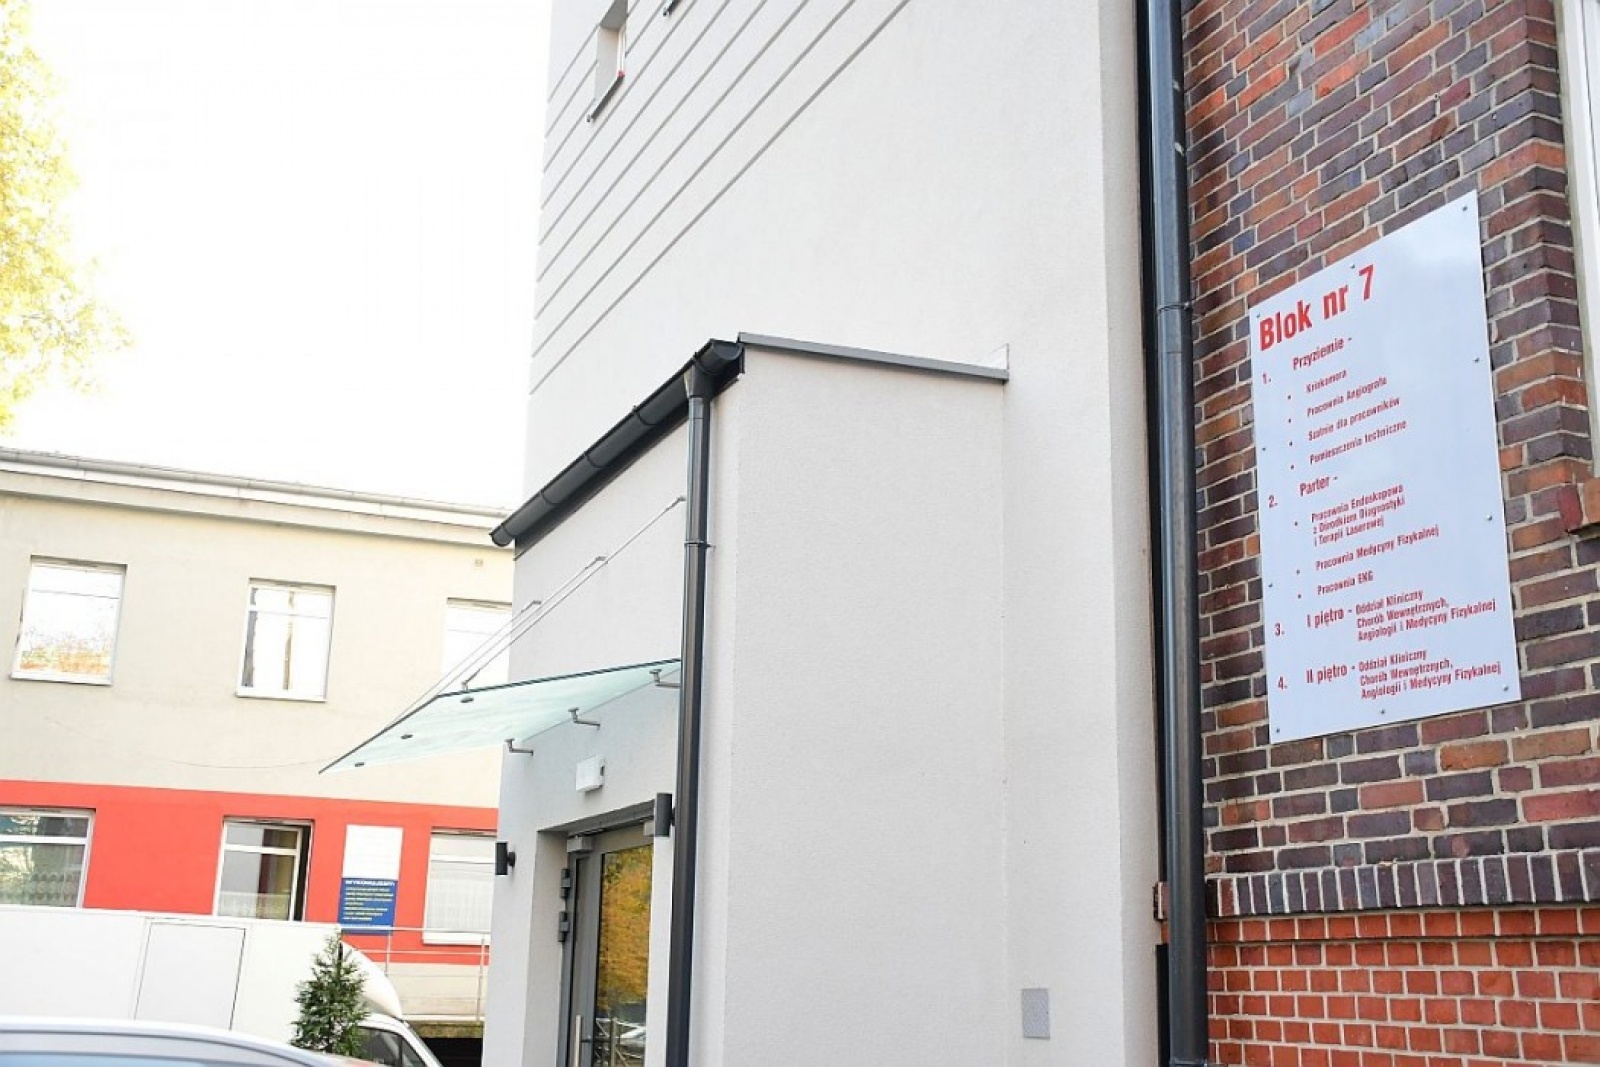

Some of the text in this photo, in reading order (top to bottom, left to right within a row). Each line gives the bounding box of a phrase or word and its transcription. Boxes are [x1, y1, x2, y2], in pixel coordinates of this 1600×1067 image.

[1260, 264, 1374, 350] Blok nr 7
[1262, 372, 1272, 384] 1.
[1293, 338, 1344, 370] Przyziemie
[1307, 396, 1344, 418] Pracownia
[1336, 418, 1348, 429] dla
[1364, 420, 1406, 442] techniczne
[1268, 494, 1278, 508] 2.
[1300, 476, 1330, 497] Parter
[1312, 484, 1404, 523] Pracownia Endoskopowa
[1359, 495, 1405, 518] Diagnostyki
[1316, 524, 1440, 570] Pracownia Medycyny Fizykalnej
[1320, 528, 1343, 544] Terapii
[1346, 515, 1384, 536] Laserowej
[1318, 570, 1374, 595] Pracownia ENG
[1274, 622, 1285, 636] 3.
[1307, 614, 1311, 628] I
[1314, 608, 1344, 628] piętro
[1386, 590, 1423, 606] Kliniczny
[1358, 622, 1397, 641] Angiologii
[1406, 613, 1447, 630] Medycyny
[1451, 598, 1496, 619] Fizykalnej
[1278, 676, 1288, 690] 4.
[1306, 669, 1313, 683] II
[1317, 664, 1347, 685] piętro
[1390, 650, 1426, 664] Kliniczny
[1362, 682, 1401, 699] Angiologii
[1410, 673, 1452, 689] Medycyny
[1455, 661, 1501, 680] Fizykalnej
